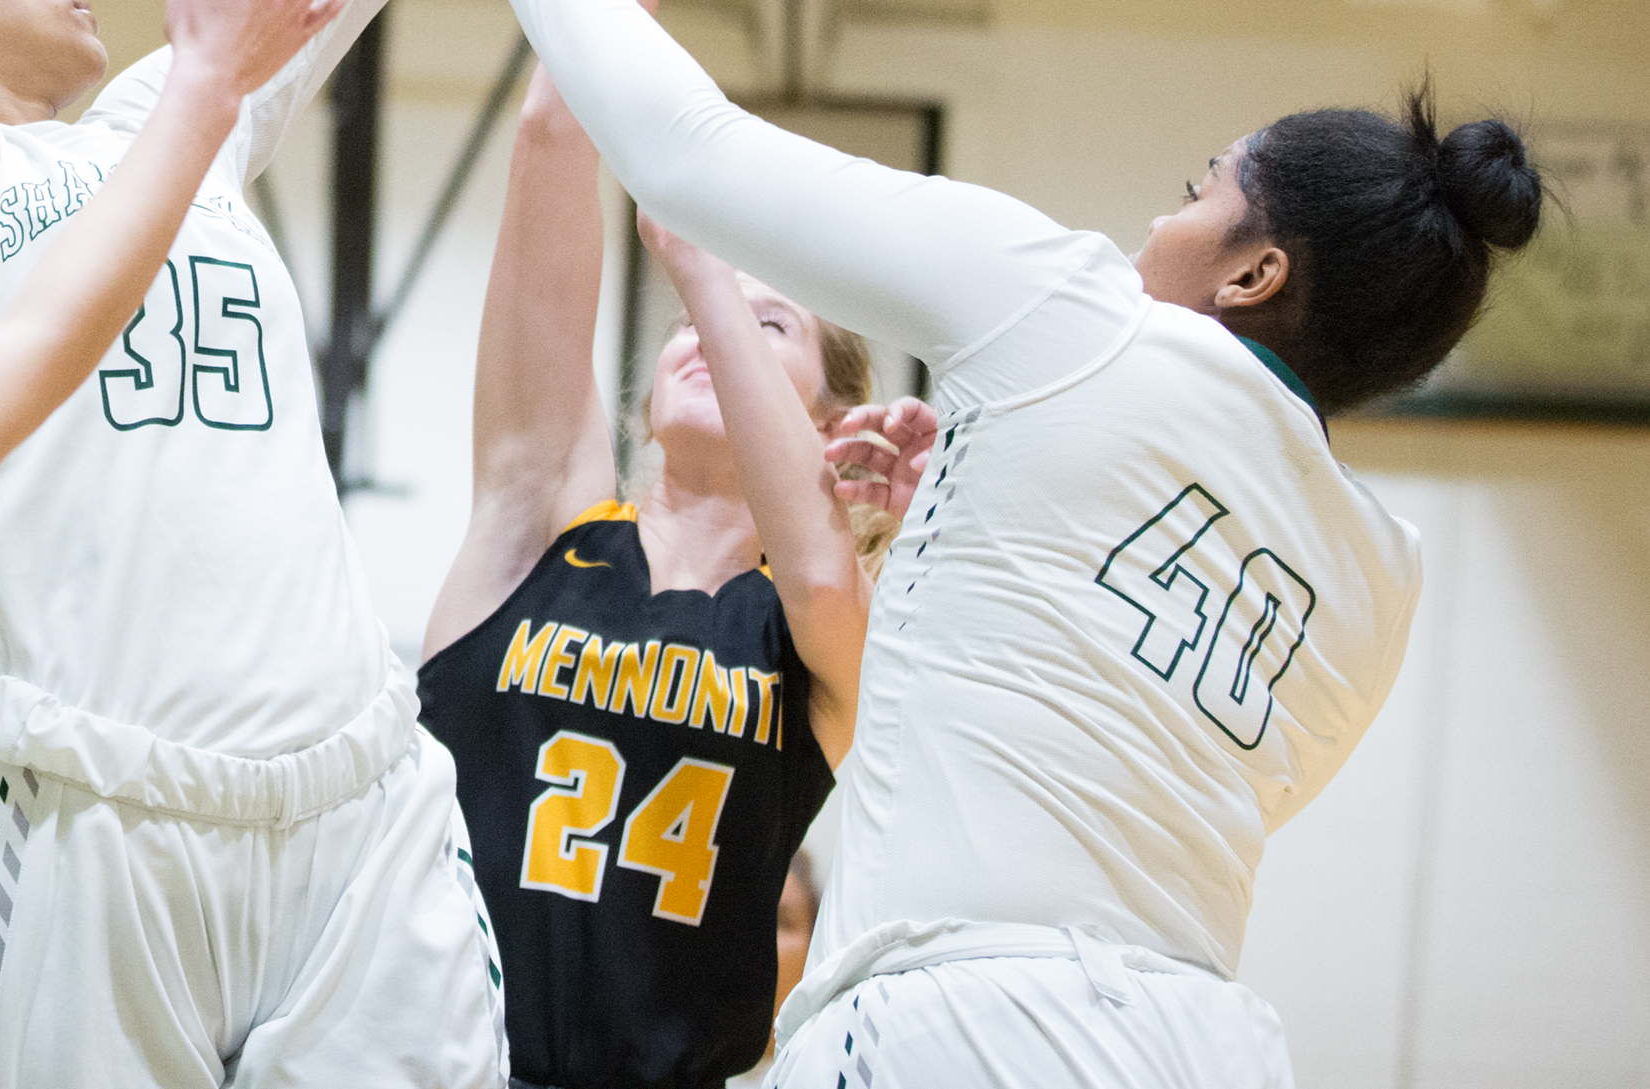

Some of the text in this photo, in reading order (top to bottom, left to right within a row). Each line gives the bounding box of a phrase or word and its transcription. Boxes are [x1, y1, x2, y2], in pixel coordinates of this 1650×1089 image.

[98, 255, 274, 432] 35
[495, 618, 783, 752] MENNONIT
[1094, 482, 1317, 751] 40
[519, 729, 736, 928] 24
